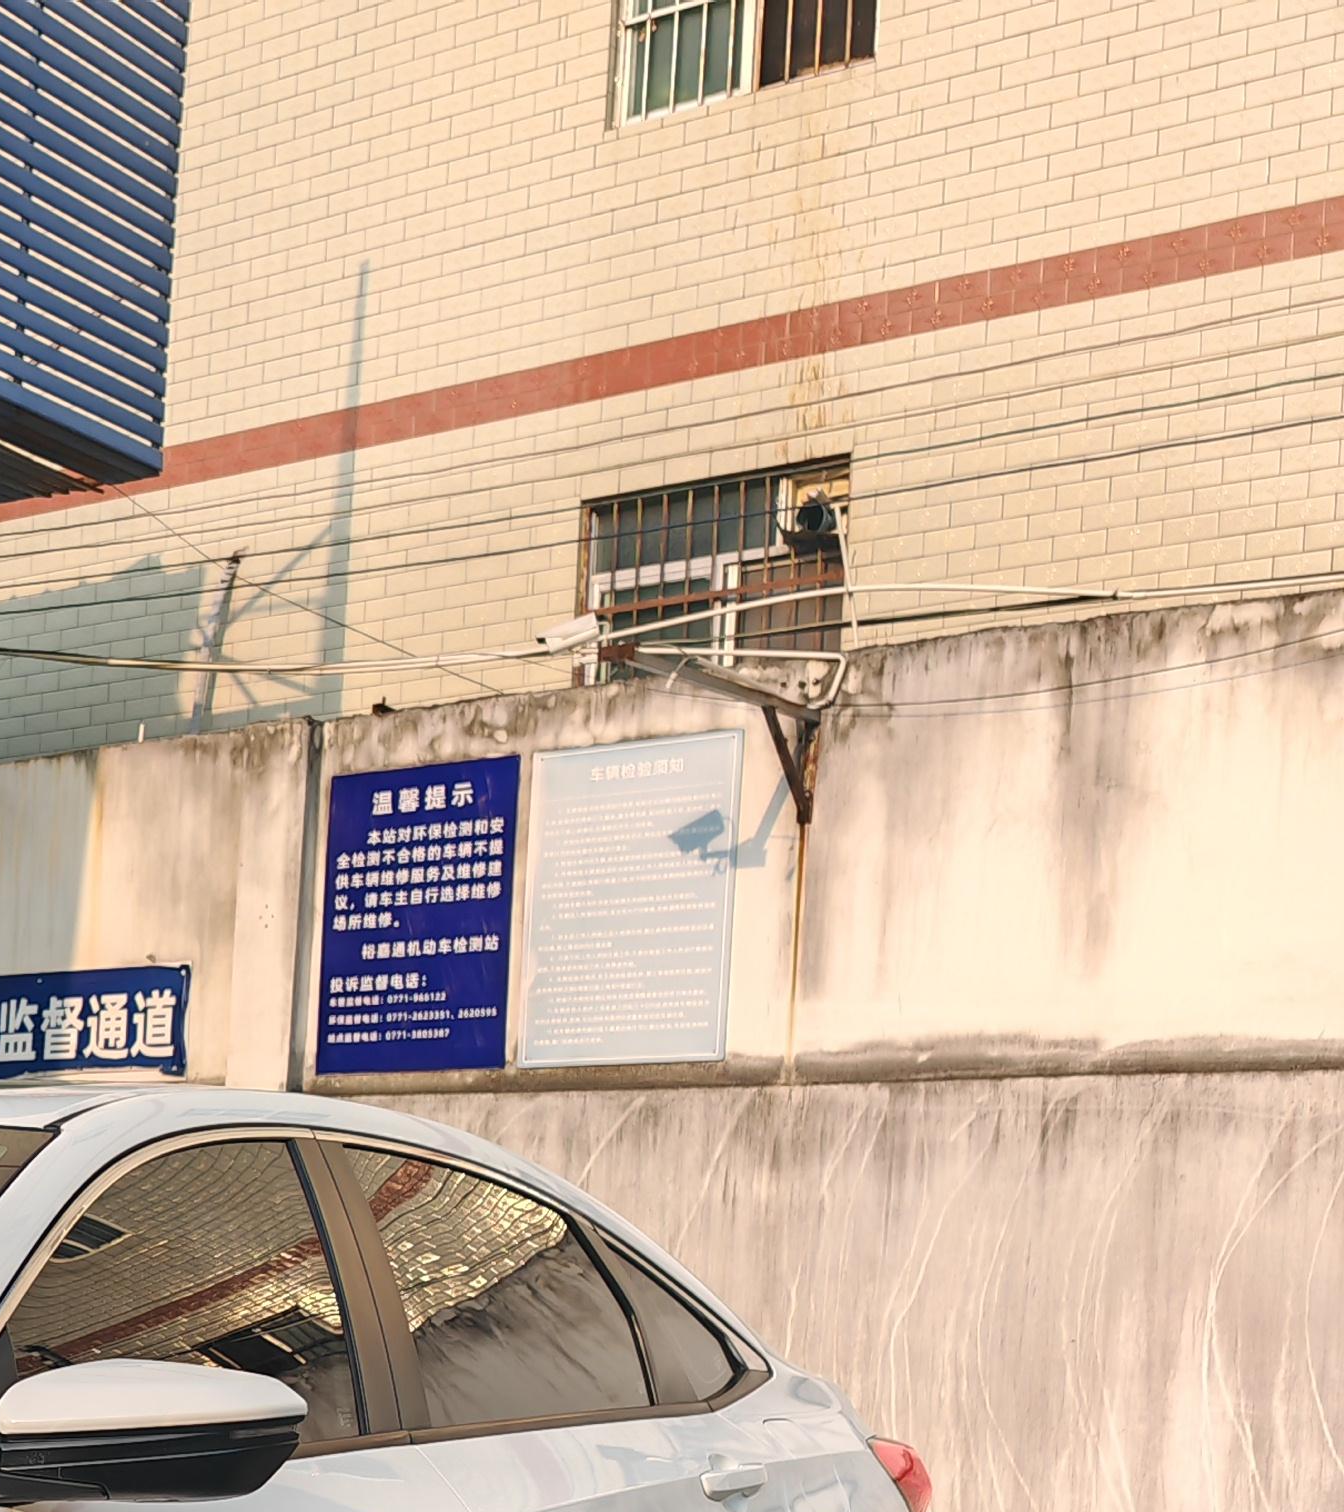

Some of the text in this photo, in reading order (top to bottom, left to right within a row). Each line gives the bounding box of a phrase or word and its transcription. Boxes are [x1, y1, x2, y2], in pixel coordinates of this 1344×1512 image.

[589, 757, 685, 783] 车辆检验须知
[371, 780, 475, 816] 温馨提示
[366, 816, 505, 846] 本站对环保检测和安
[336, 839, 504, 870] 全检测不合格的车辆不提
[334, 860, 503, 891] 供车辆维修服务及维修建
